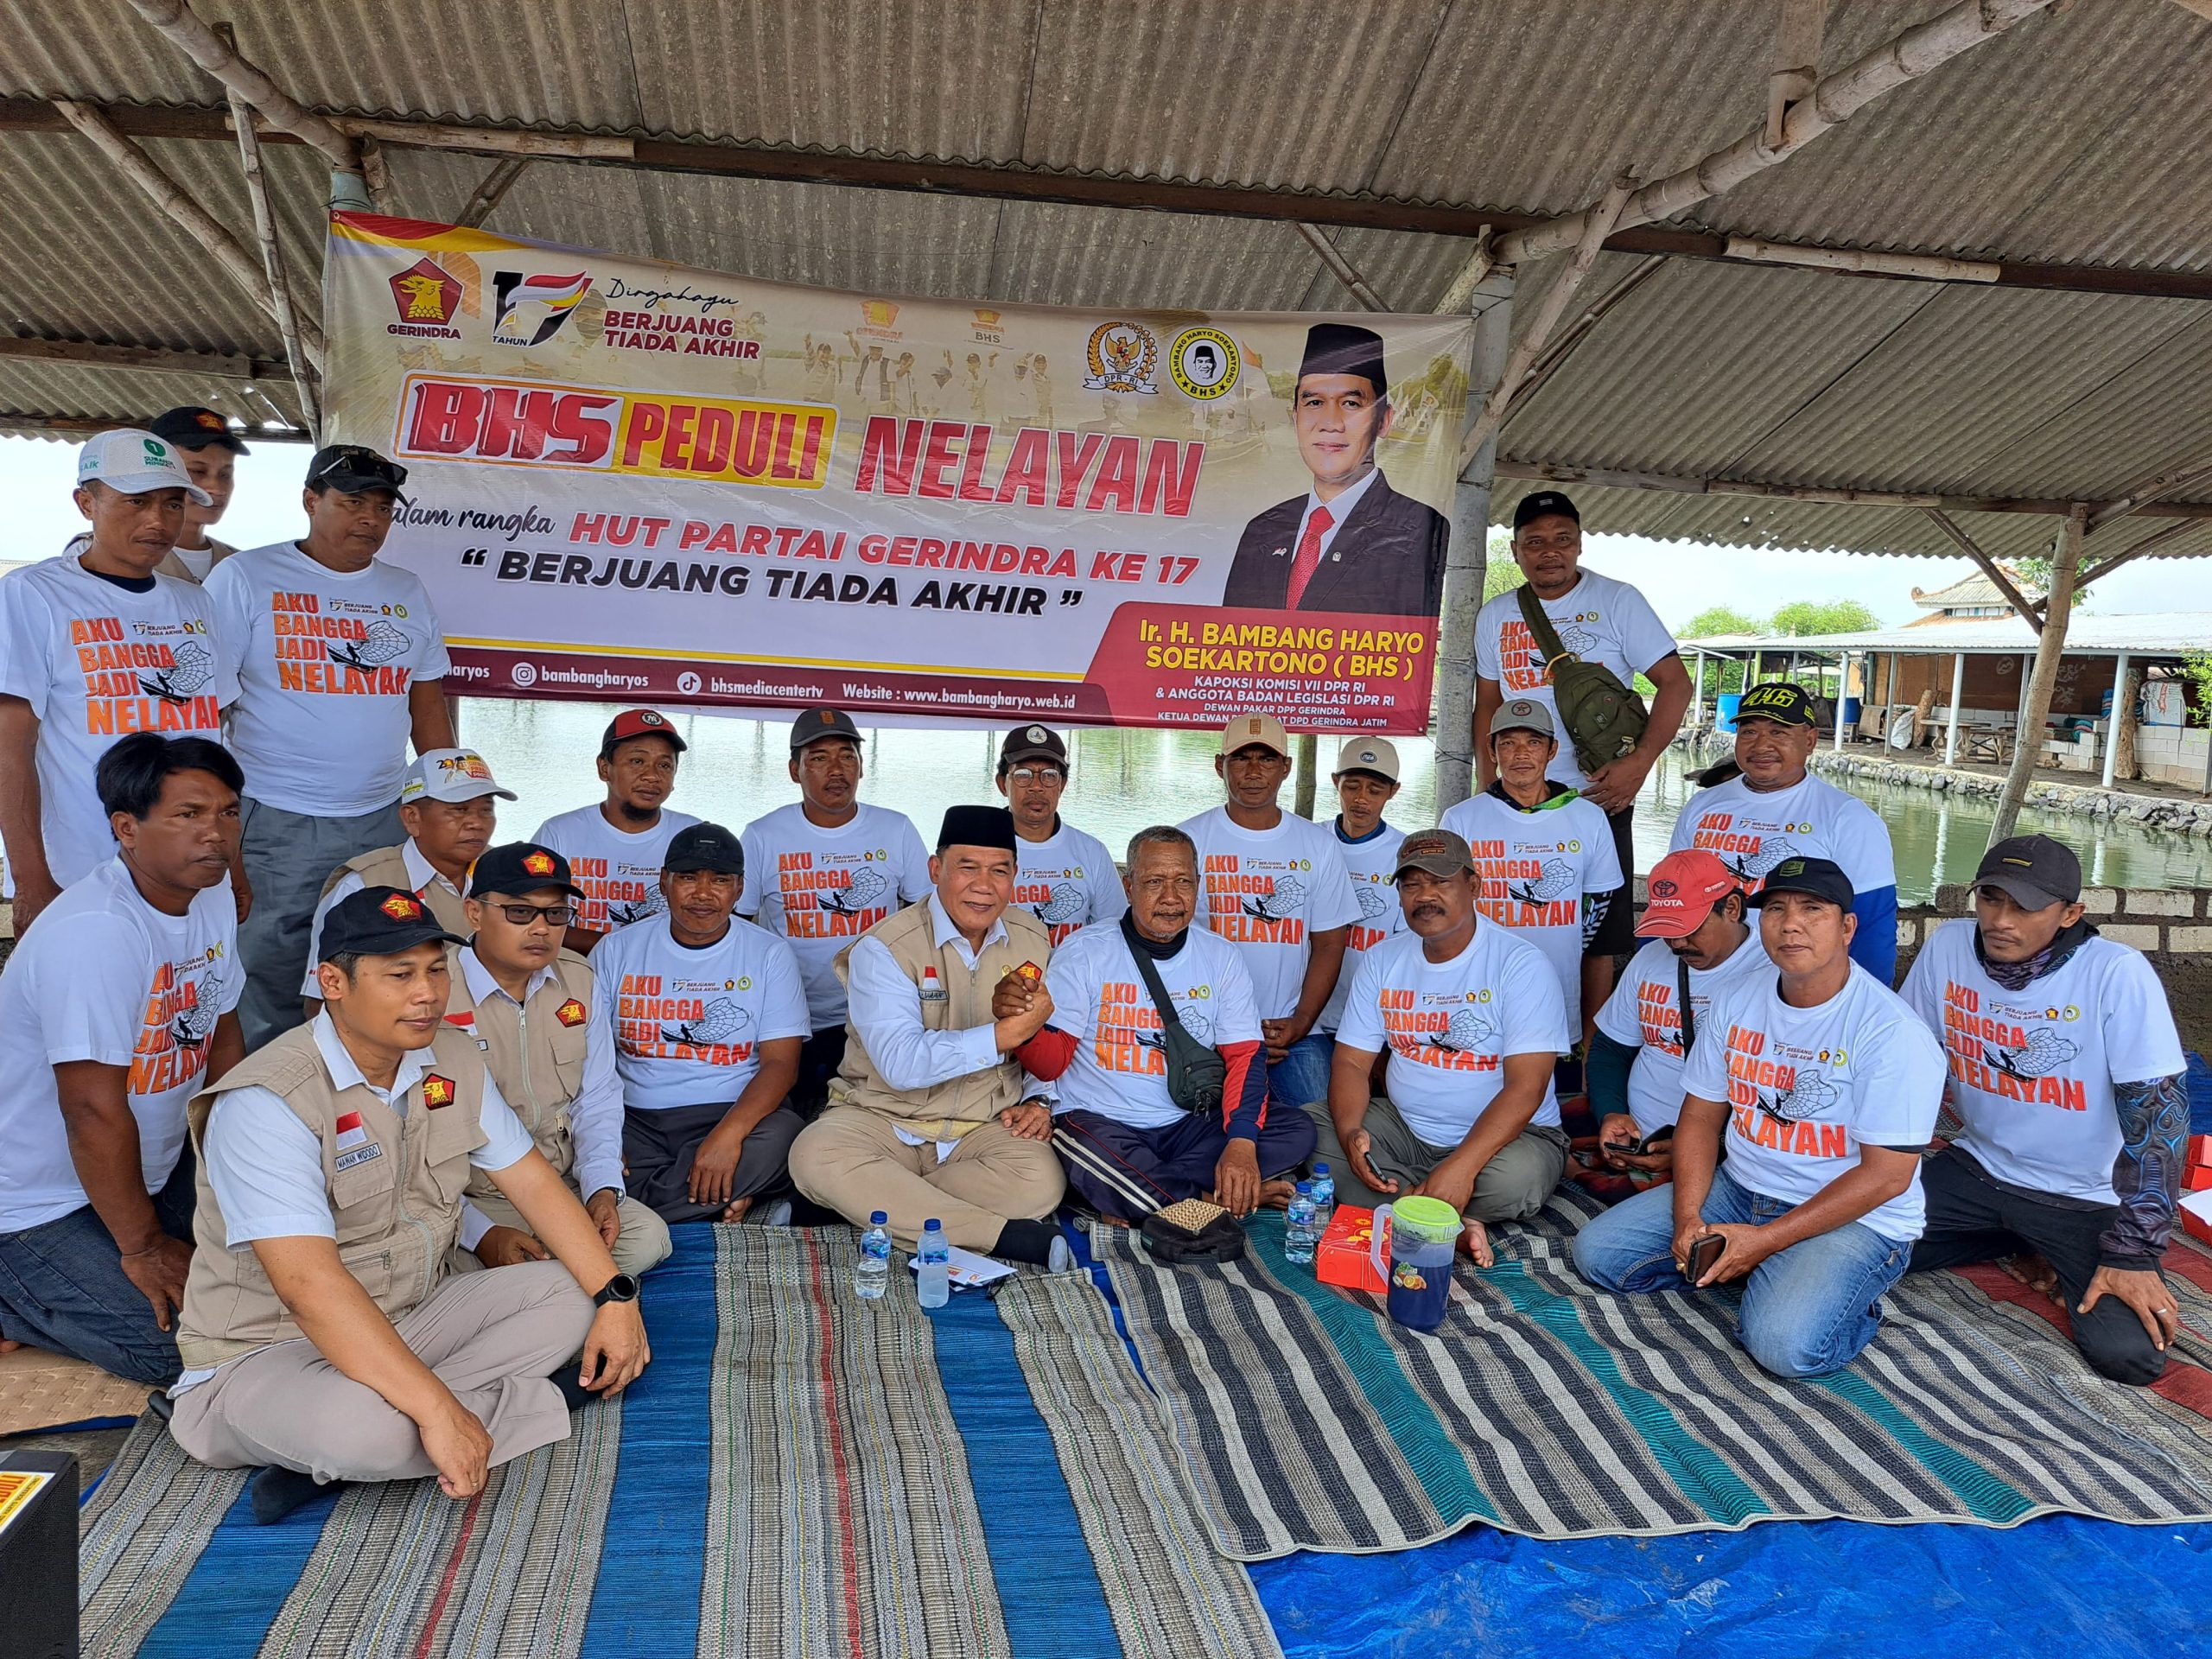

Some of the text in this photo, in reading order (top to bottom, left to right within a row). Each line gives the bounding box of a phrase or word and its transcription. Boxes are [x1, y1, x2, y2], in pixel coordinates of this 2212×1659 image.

[387, 324, 461, 340] GERINDRA
[605, 310, 734, 337] BERJUANG
[493, 335, 528, 346] TAHUN
[605, 330, 760, 359] TIADA AKHIR
[976, 332, 1001, 344] BHS
[1173, 331, 1236, 384] BAMBANG HARYO SOEKARTONO
[1191, 386, 1217, 397] BHS
[407, 382, 1206, 518] BHS PEDULI NELAYAN
[391, 497, 1200, 585] alam rangka HUT PARTAI GERINDRA KE 17
[496, 550, 751, 596] BERJUANG
[766, 568, 899, 606] TIADA
[912, 580, 1047, 616] AKHIR
[272, 591, 320, 614] AKU
[70, 617, 124, 645] AKU
[274, 613, 368, 640] BANGGA
[1140, 619, 1424, 653] Ir. H. BAMBANG HARYO
[77, 642, 177, 673] BANGGA
[275, 638, 327, 661] JADI
[1146, 645, 1327, 674] SOEKARTONO
[1350, 656, 1398, 678] BHS
[86, 671, 141, 697] JADI
[541, 664, 649, 689] bambangharyos
[710, 677, 823, 698] bhsmediacentertv
[842, 682, 891, 701] Website
[904, 689, 1076, 710] www.bambangharyo.web.id
[1194, 676, 1365, 693] KAPOKSI KOMISI VII DPR RI
[1155, 687, 1395, 707] & ANGGOTA BADAN LEGISLASI DPR RI
[1204, 702, 1241, 712] DEWAN
[1243, 704, 1274, 714] PAKAR
[1299, 706, 1346, 715] GERINDRA
[1742, 688, 1798, 708] 46
[1158, 712, 1190, 721] KETUA
[1192, 713, 1229, 722] DEWAN
[1290, 717, 1307, 726] DPD
[1311, 718, 1357, 727] GERINDRA
[1697, 812, 1733, 831] AKU
[1471, 840, 1505, 858] AKU
[1694, 830, 1761, 855] BANGGA
[570, 857, 608, 878] AKU
[779, 851, 813, 873] AKU
[1205, 855, 1238, 874] AKU
[779, 868, 853, 893] BANGGA
[1206, 874, 1275, 895] BANGGA
[1481, 880, 1508, 899] ADI
[783, 892, 817, 912] JADI
[1476, 899, 1577, 927] NELAYAN
[151, 962, 173, 994] AU
[619, 974, 662, 996] AKU
[1101, 982, 1137, 1004] AKU
[1379, 988, 1414, 1010] AKU
[1637, 981, 1671, 1004] AKU
[1944, 981, 1979, 1013] AKU
[619, 996, 705, 1020] BANGGA
[1098, 1003, 1166, 1028] BANGG
[1945, 1003, 2027, 1048] BANGGA
[1728, 1024, 1764, 1056] AKU
[1946, 1028, 1983, 1061] JADI
[1728, 1078, 1758, 1106] ADI
[1947, 1049, 2088, 1111] NELAYAN
[1732, 1105, 1846, 1158] ELAYAN
